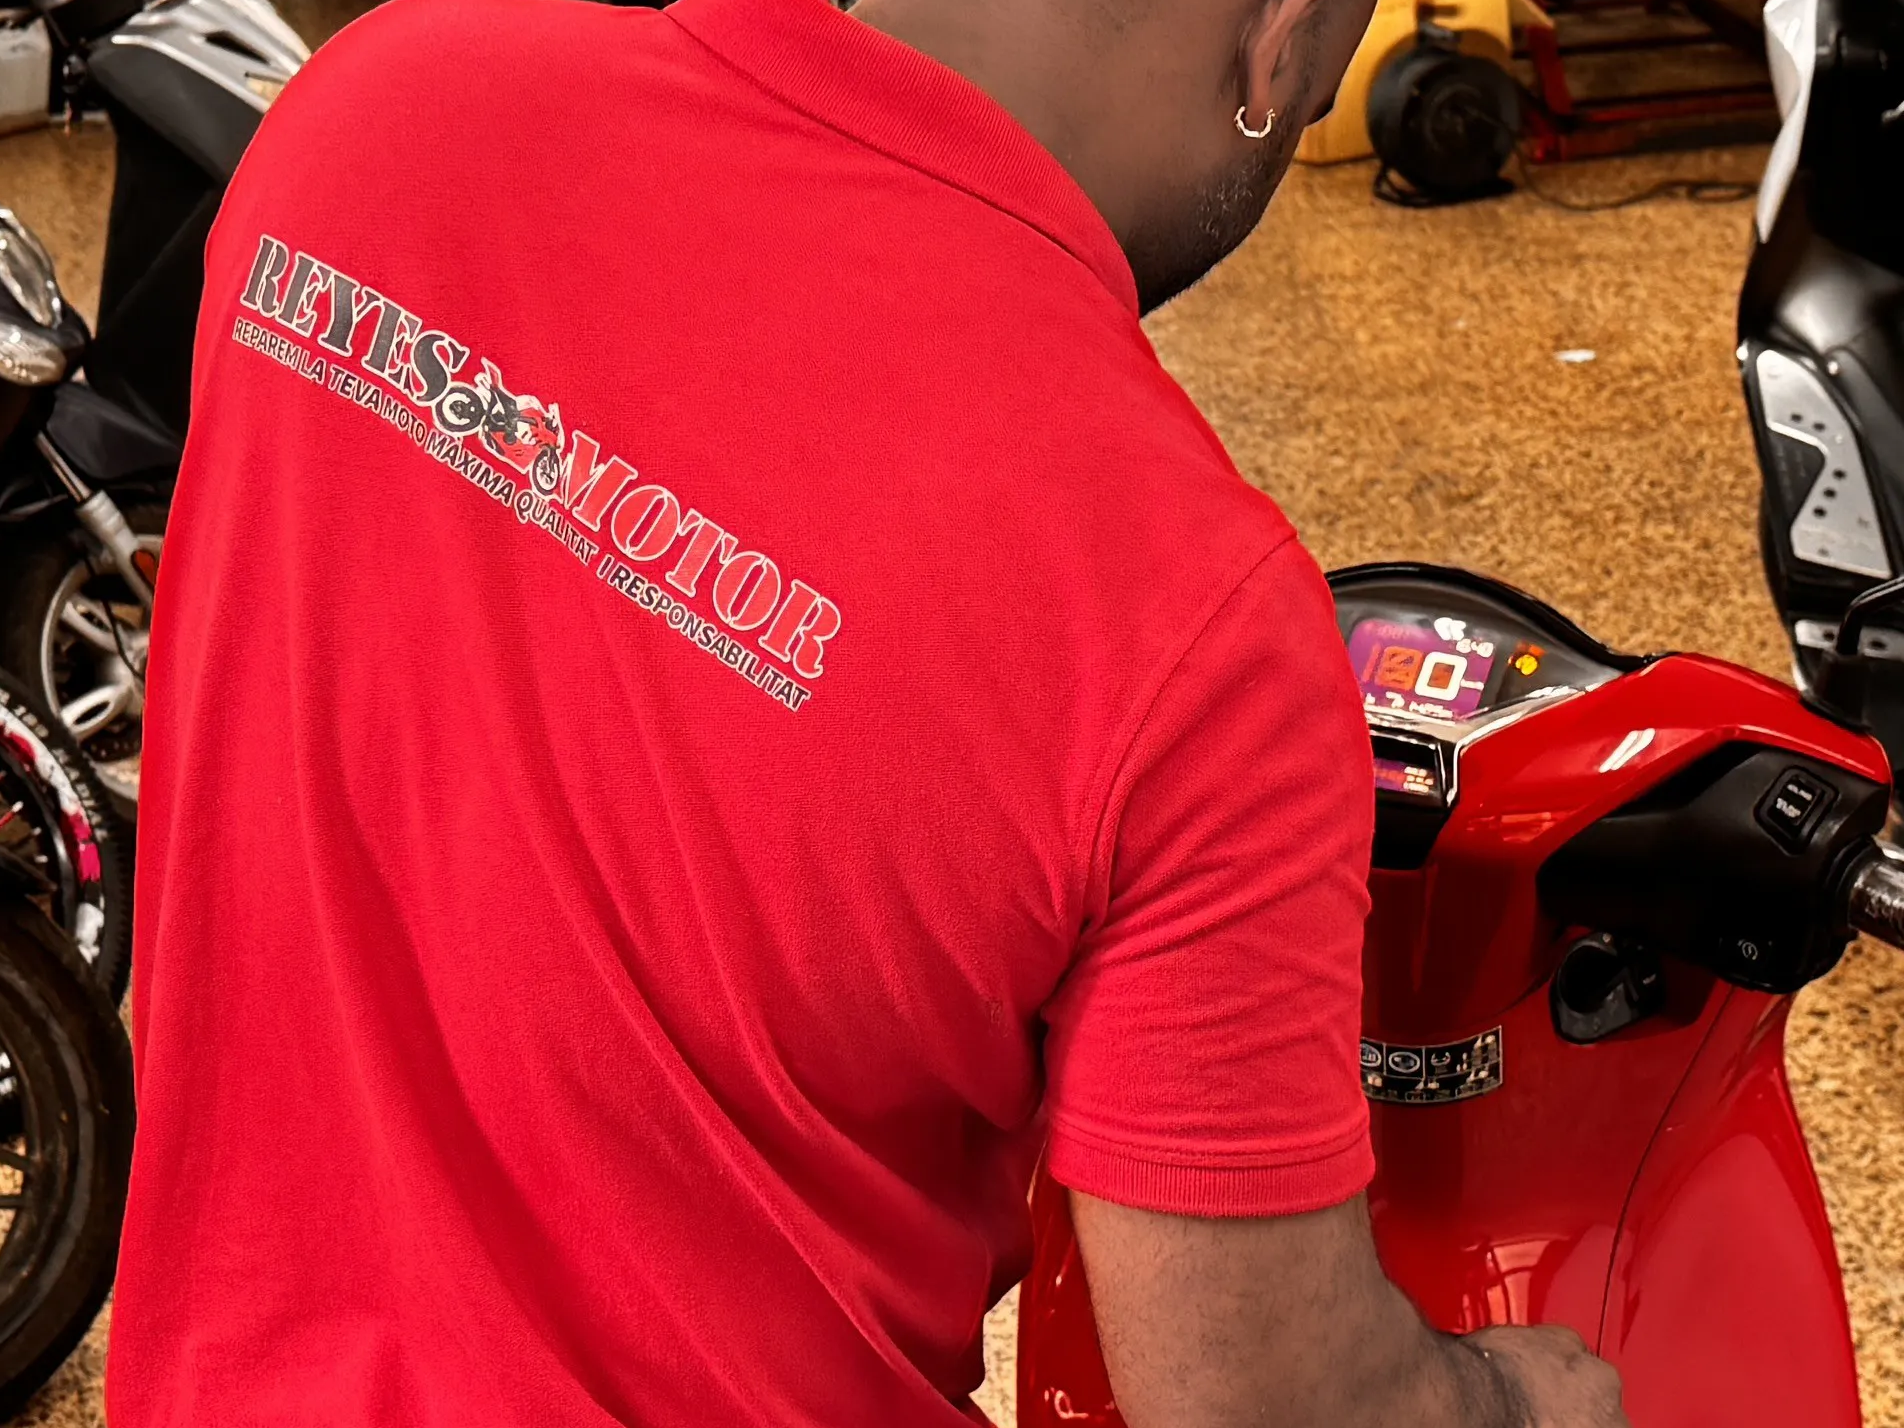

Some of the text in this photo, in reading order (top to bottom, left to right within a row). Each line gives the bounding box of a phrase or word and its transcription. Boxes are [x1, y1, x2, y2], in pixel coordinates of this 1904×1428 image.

[232, 317, 301, 370] REPAREM
[298, 349, 327, 384] LA
[327, 366, 384, 414] TEVA
[381, 394, 431, 447] MOTO
[513, 489, 599, 566] QUALITAT
[596, 553, 615, 580] I
[609, 564, 812, 713] RESPONSABILITAT
[240, 234, 841, 678] REYES MOTOR
